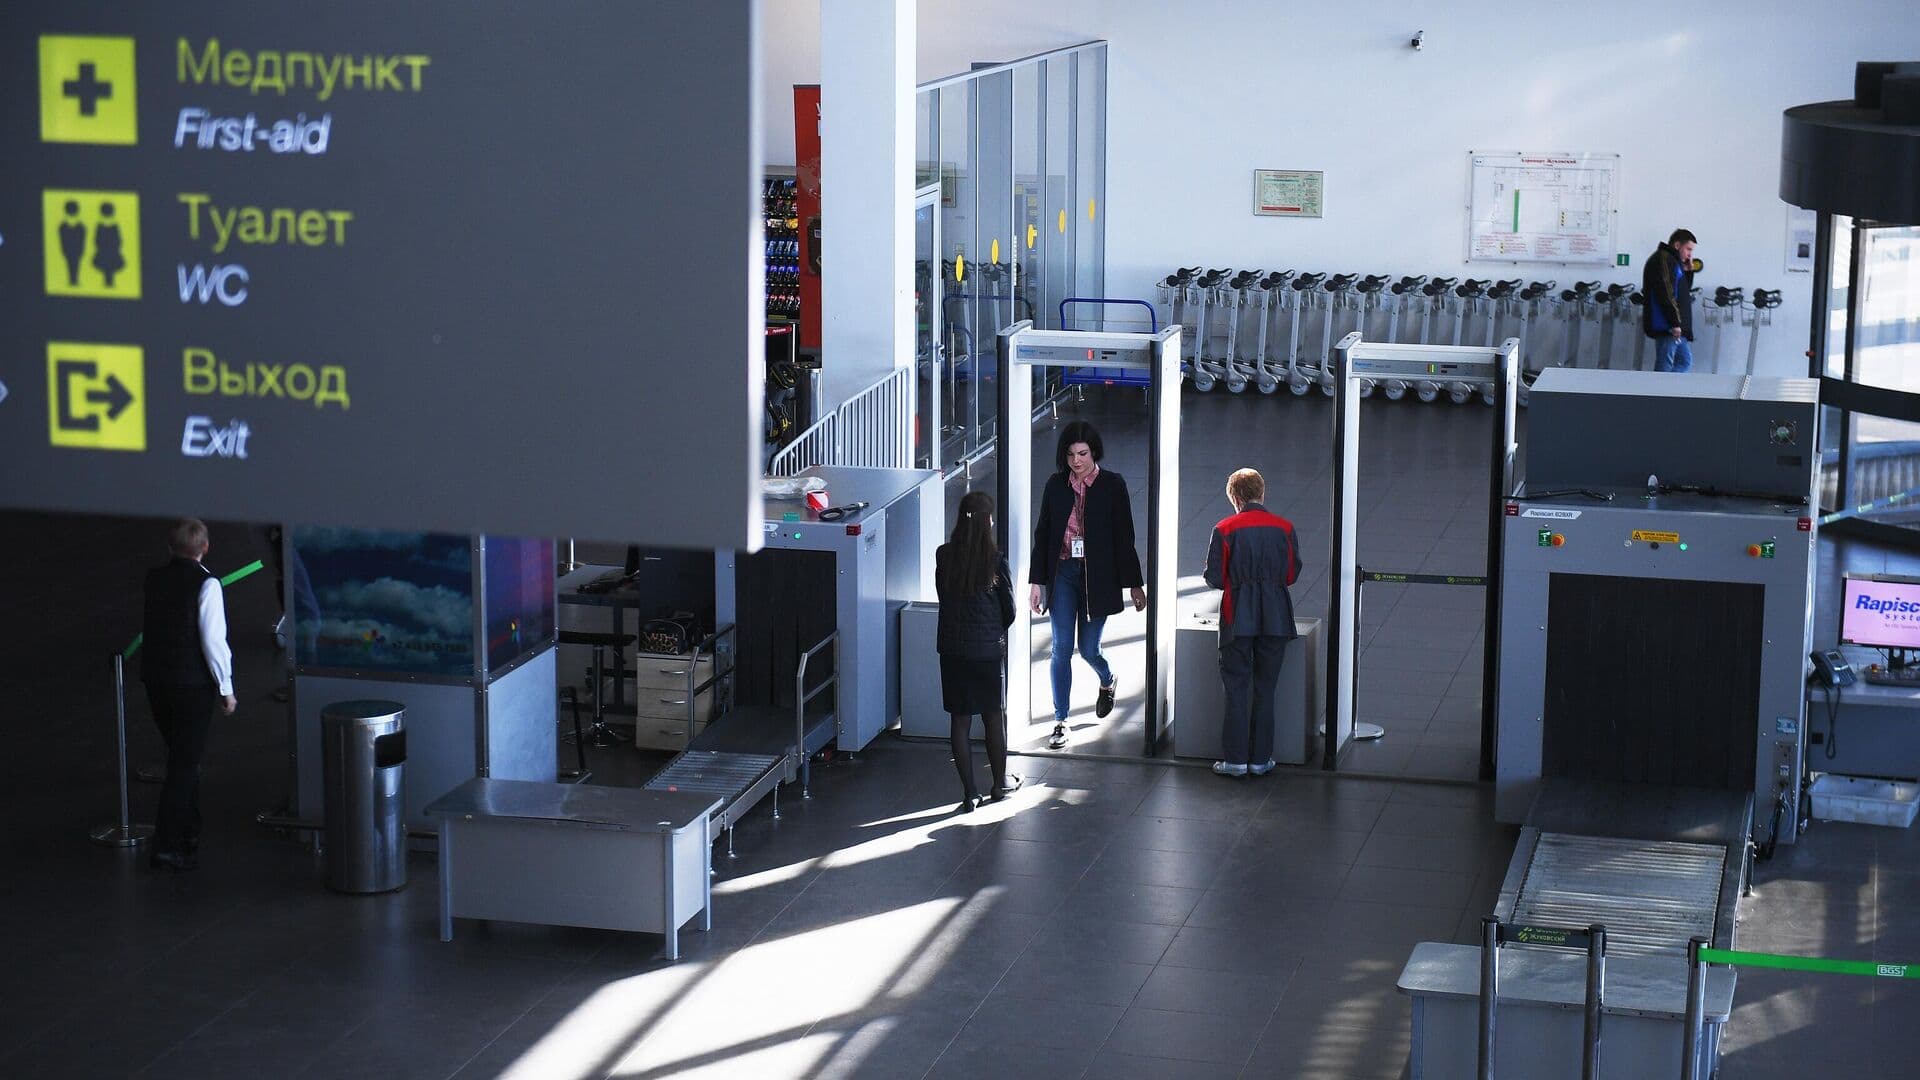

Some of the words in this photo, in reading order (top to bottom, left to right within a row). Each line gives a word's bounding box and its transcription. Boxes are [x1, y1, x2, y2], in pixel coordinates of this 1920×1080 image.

[177, 37, 430, 101] Медпункт
[175, 107, 331, 155] First-aid
[179, 195, 353, 253] Туалет
[178, 264, 249, 307] WC
[183, 349, 350, 410] Выход
[181, 416, 250, 460] Exit
[1880, 966, 1901, 975] BGS
